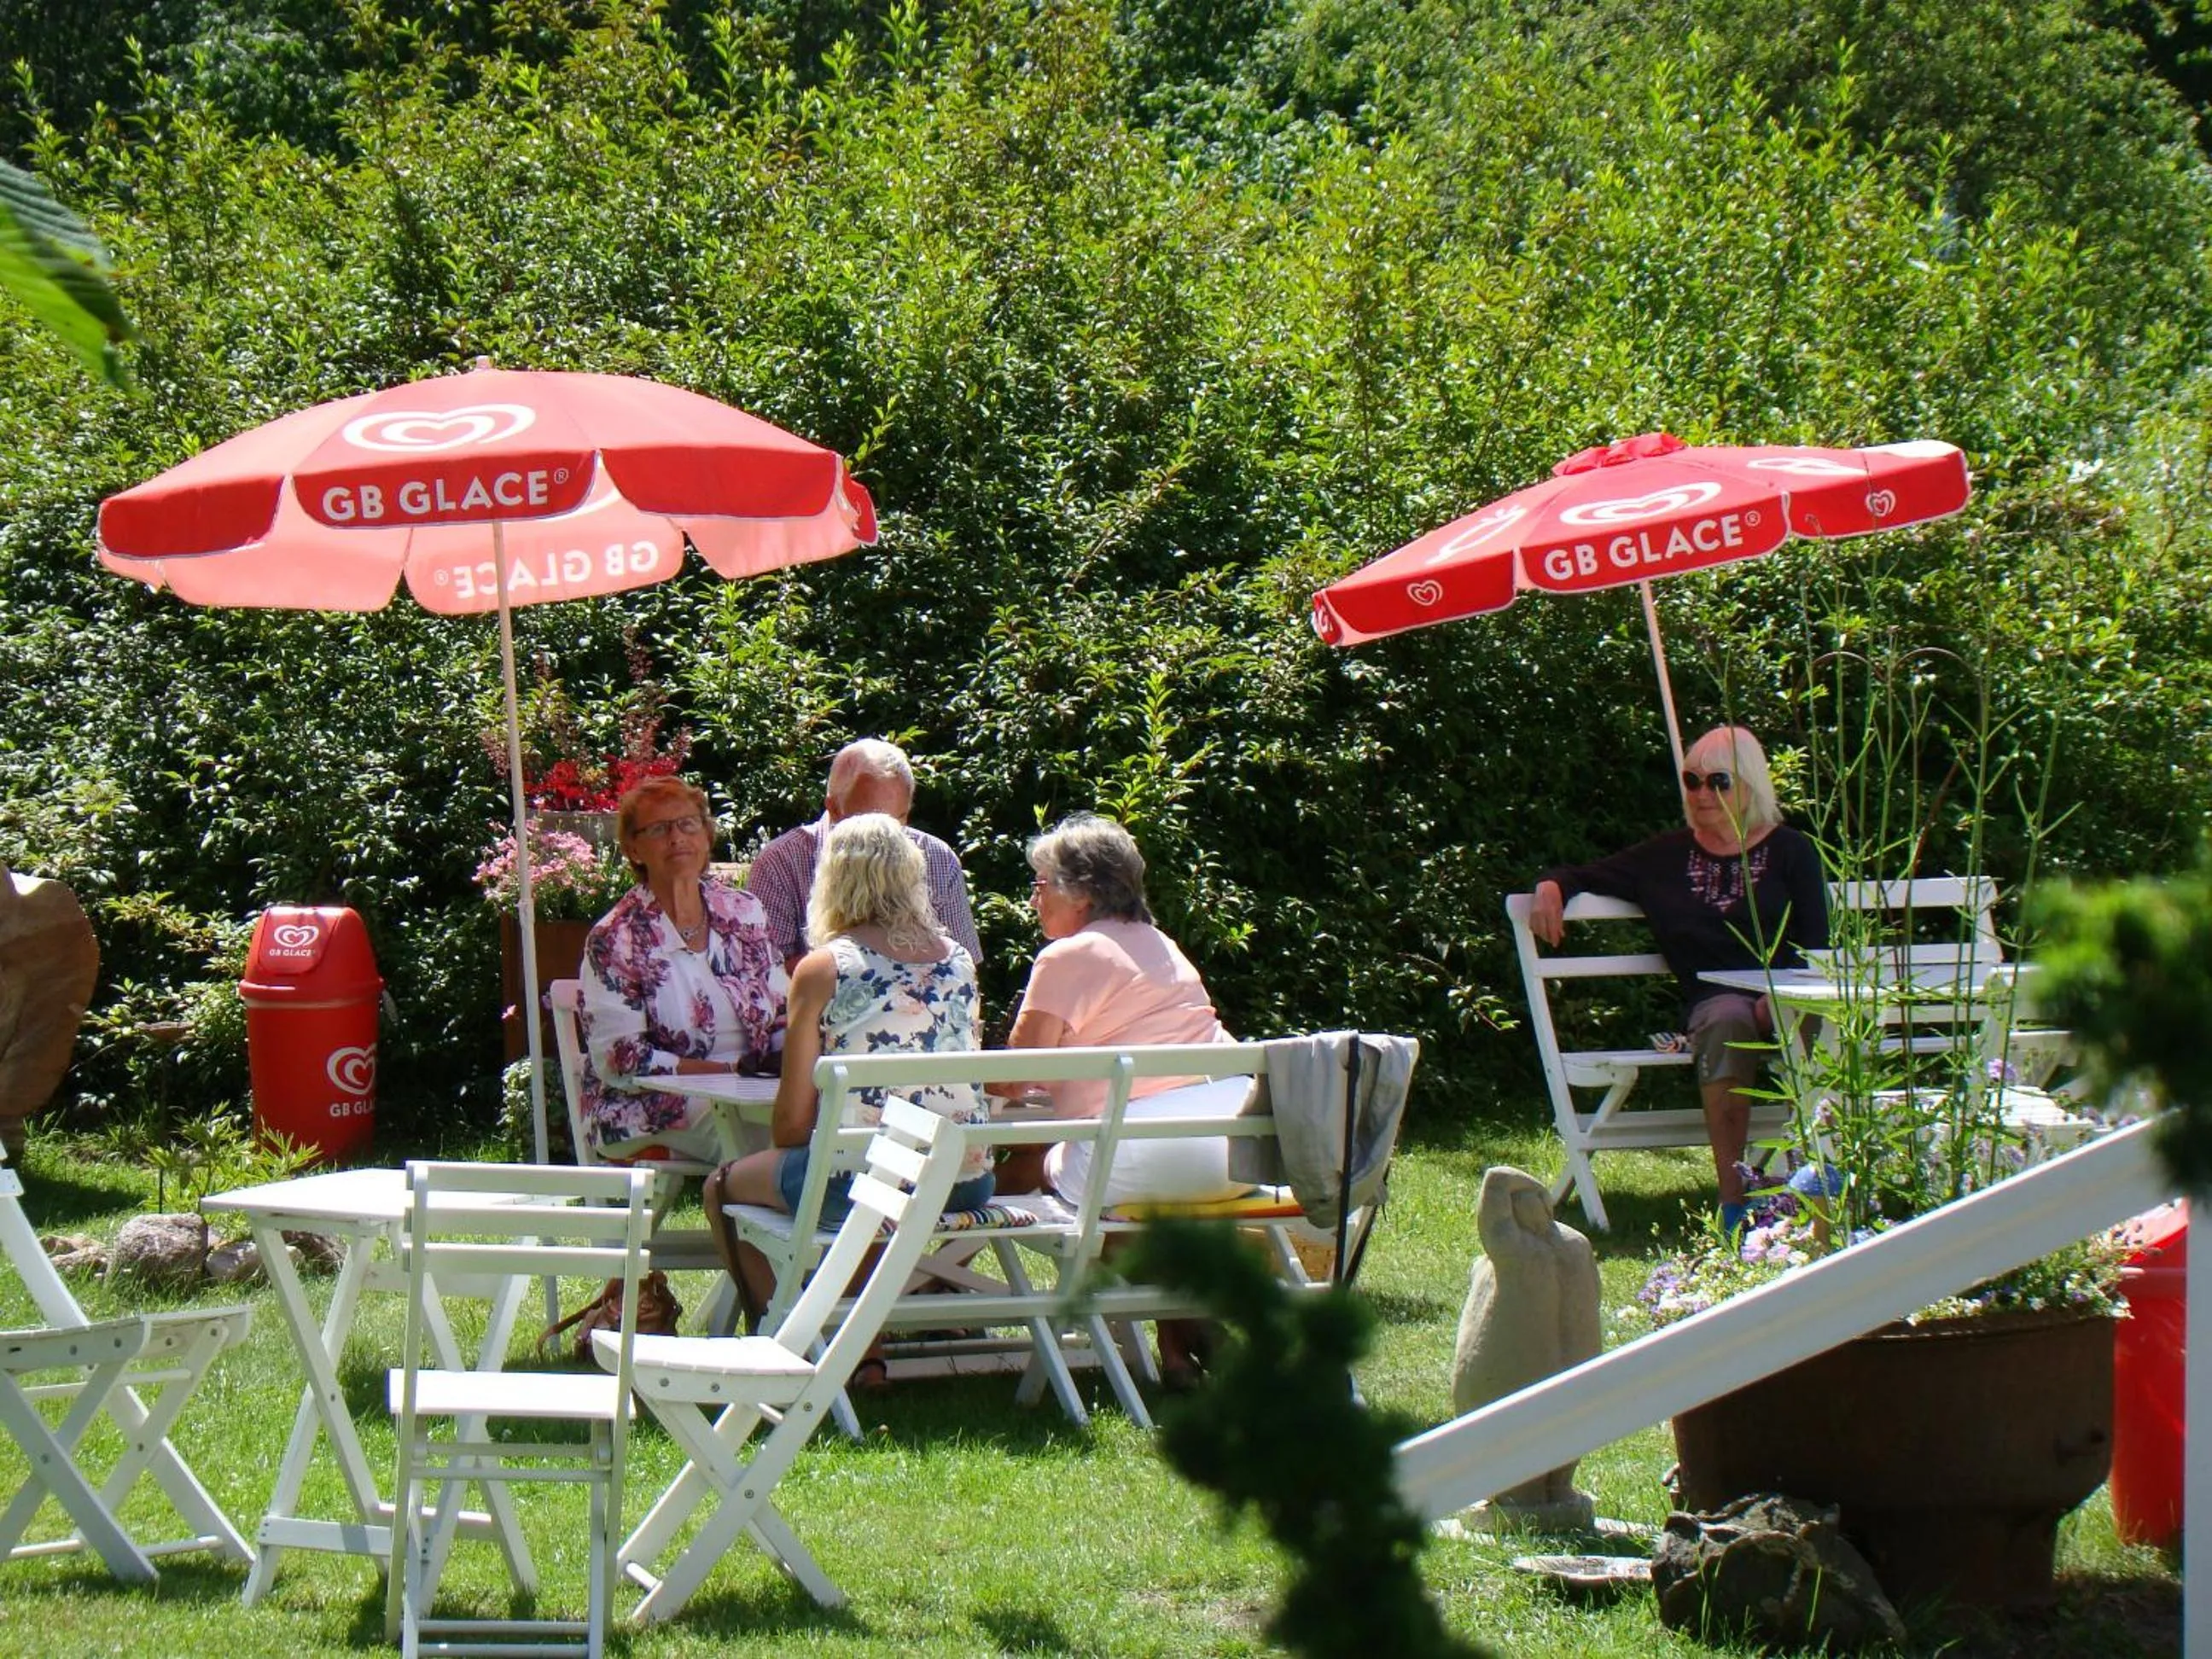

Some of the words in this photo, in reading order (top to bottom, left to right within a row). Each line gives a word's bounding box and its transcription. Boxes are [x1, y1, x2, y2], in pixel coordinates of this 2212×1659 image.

[322, 486, 384, 521] GB
[1545, 544, 1598, 579] GB
[329, 1102, 350, 1117] GB
